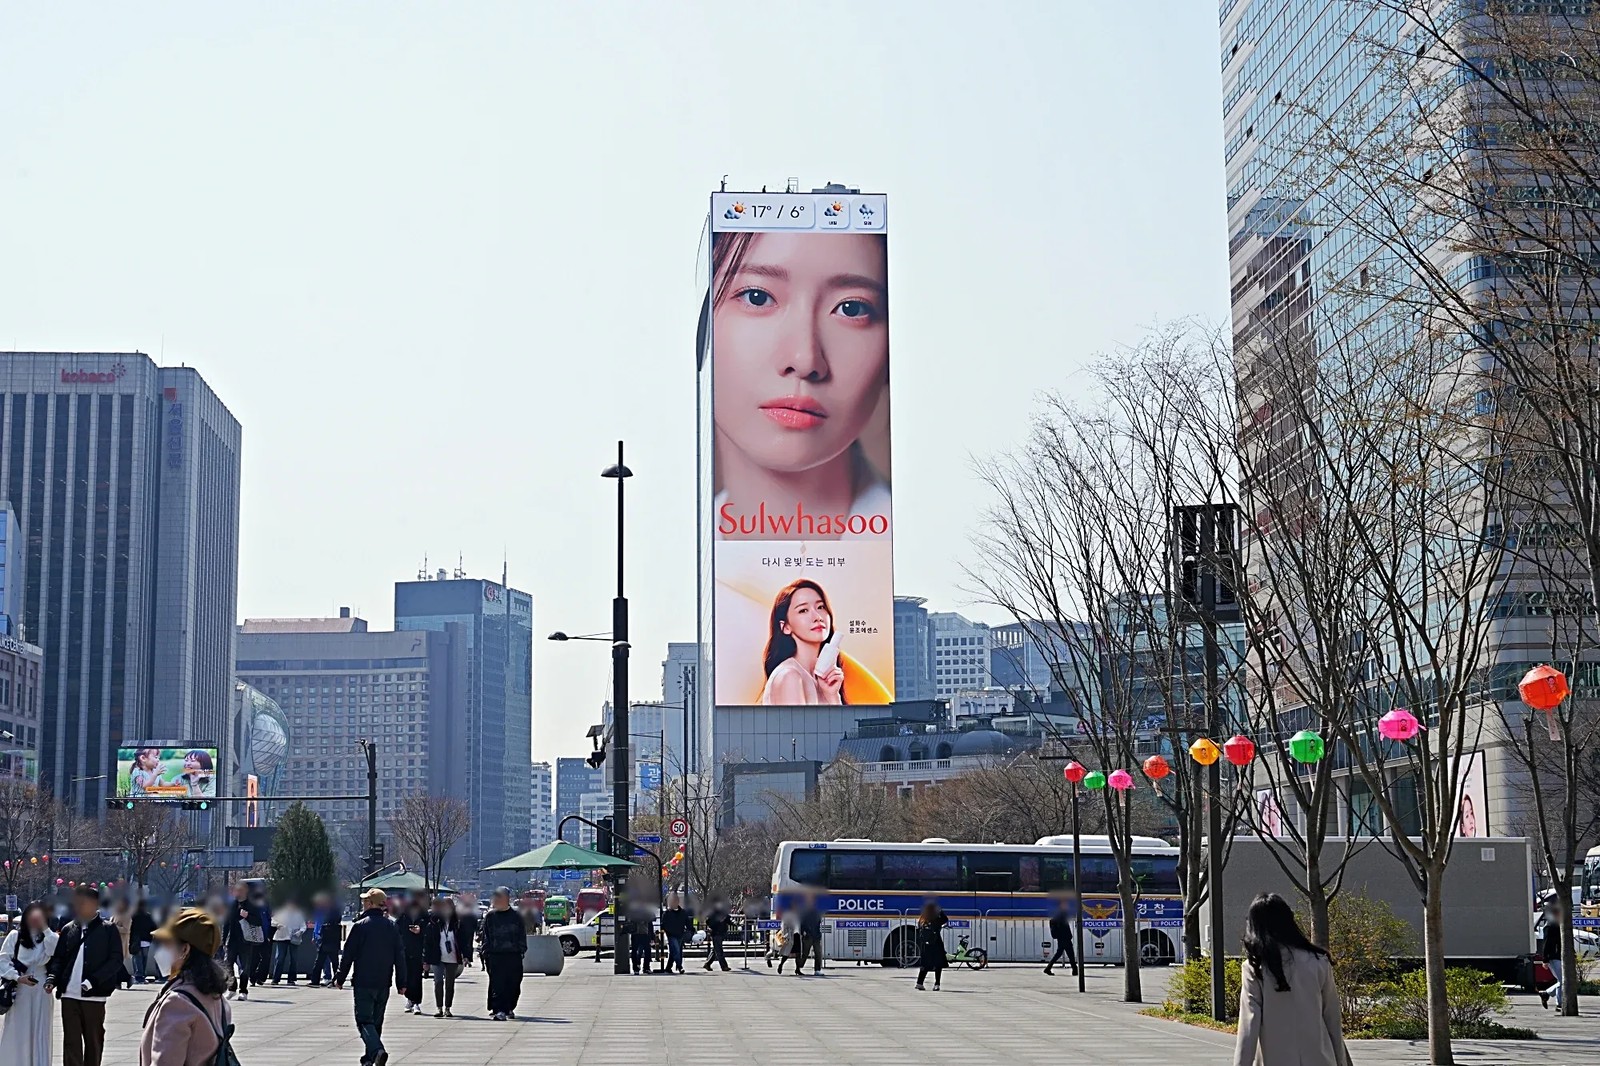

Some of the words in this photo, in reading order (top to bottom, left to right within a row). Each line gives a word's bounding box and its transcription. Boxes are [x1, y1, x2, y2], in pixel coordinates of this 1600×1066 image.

[752, 205, 772, 218] 17°
[790, 205, 805, 218] 6°
[61, 368, 115, 383] kobaco
[718, 501, 888, 535] Sulwhasoo
[761, 557, 780, 567] 다시
[784, 557, 802, 567] 윤빛
[805, 557, 824, 567] 도는
[827, 557, 845, 567] 피부
[673, 823, 685, 833] 50
[838, 899, 884, 910] POLICE
